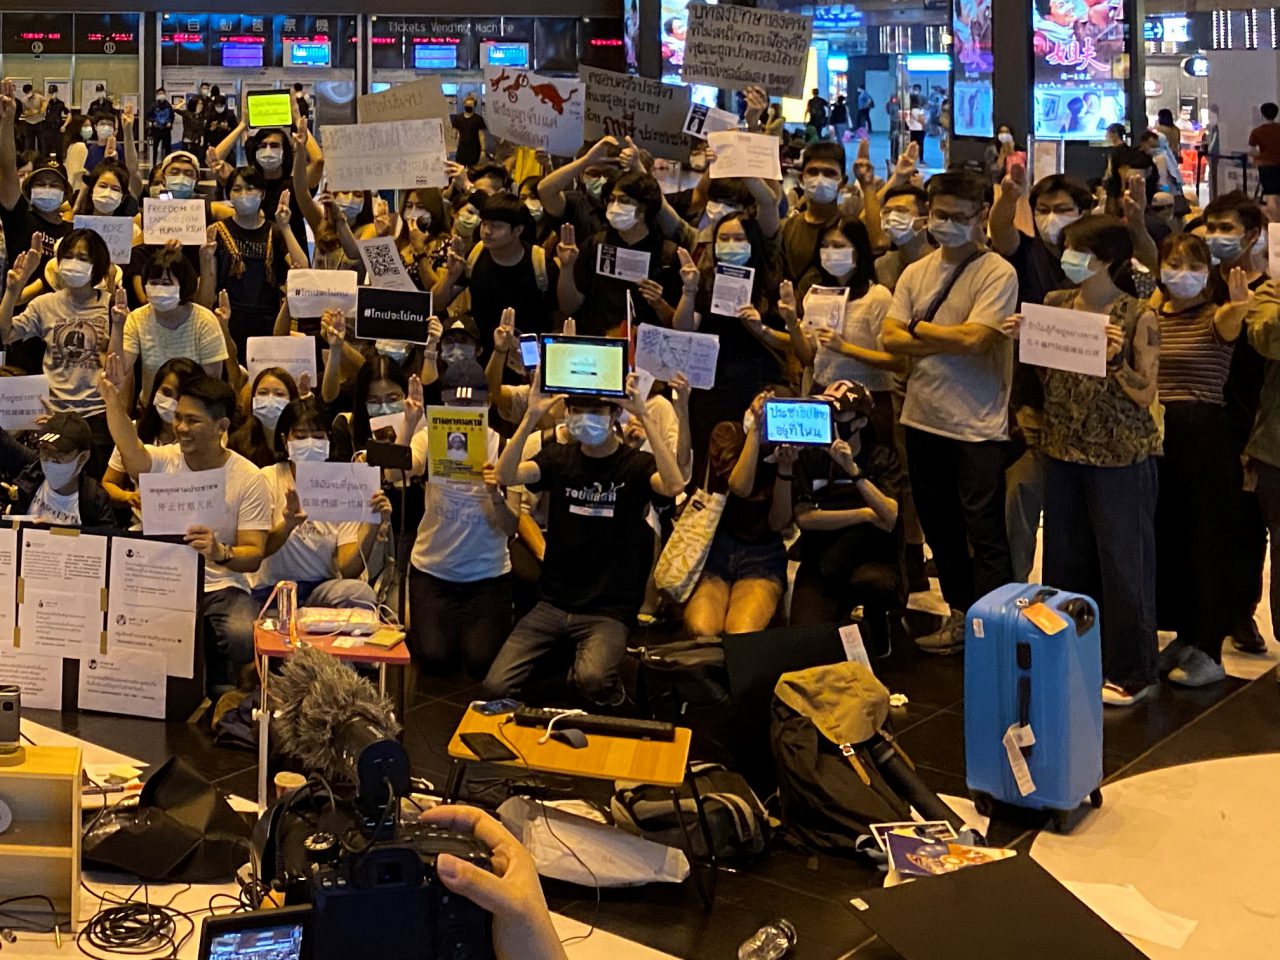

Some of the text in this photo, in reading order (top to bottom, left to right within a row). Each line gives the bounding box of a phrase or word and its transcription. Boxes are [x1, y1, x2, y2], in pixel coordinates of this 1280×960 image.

[389, 21, 515, 35] Tickets Vending Machine
[148, 204, 187, 213] FREEDOM
[159, 226, 183, 235] HUMAN
